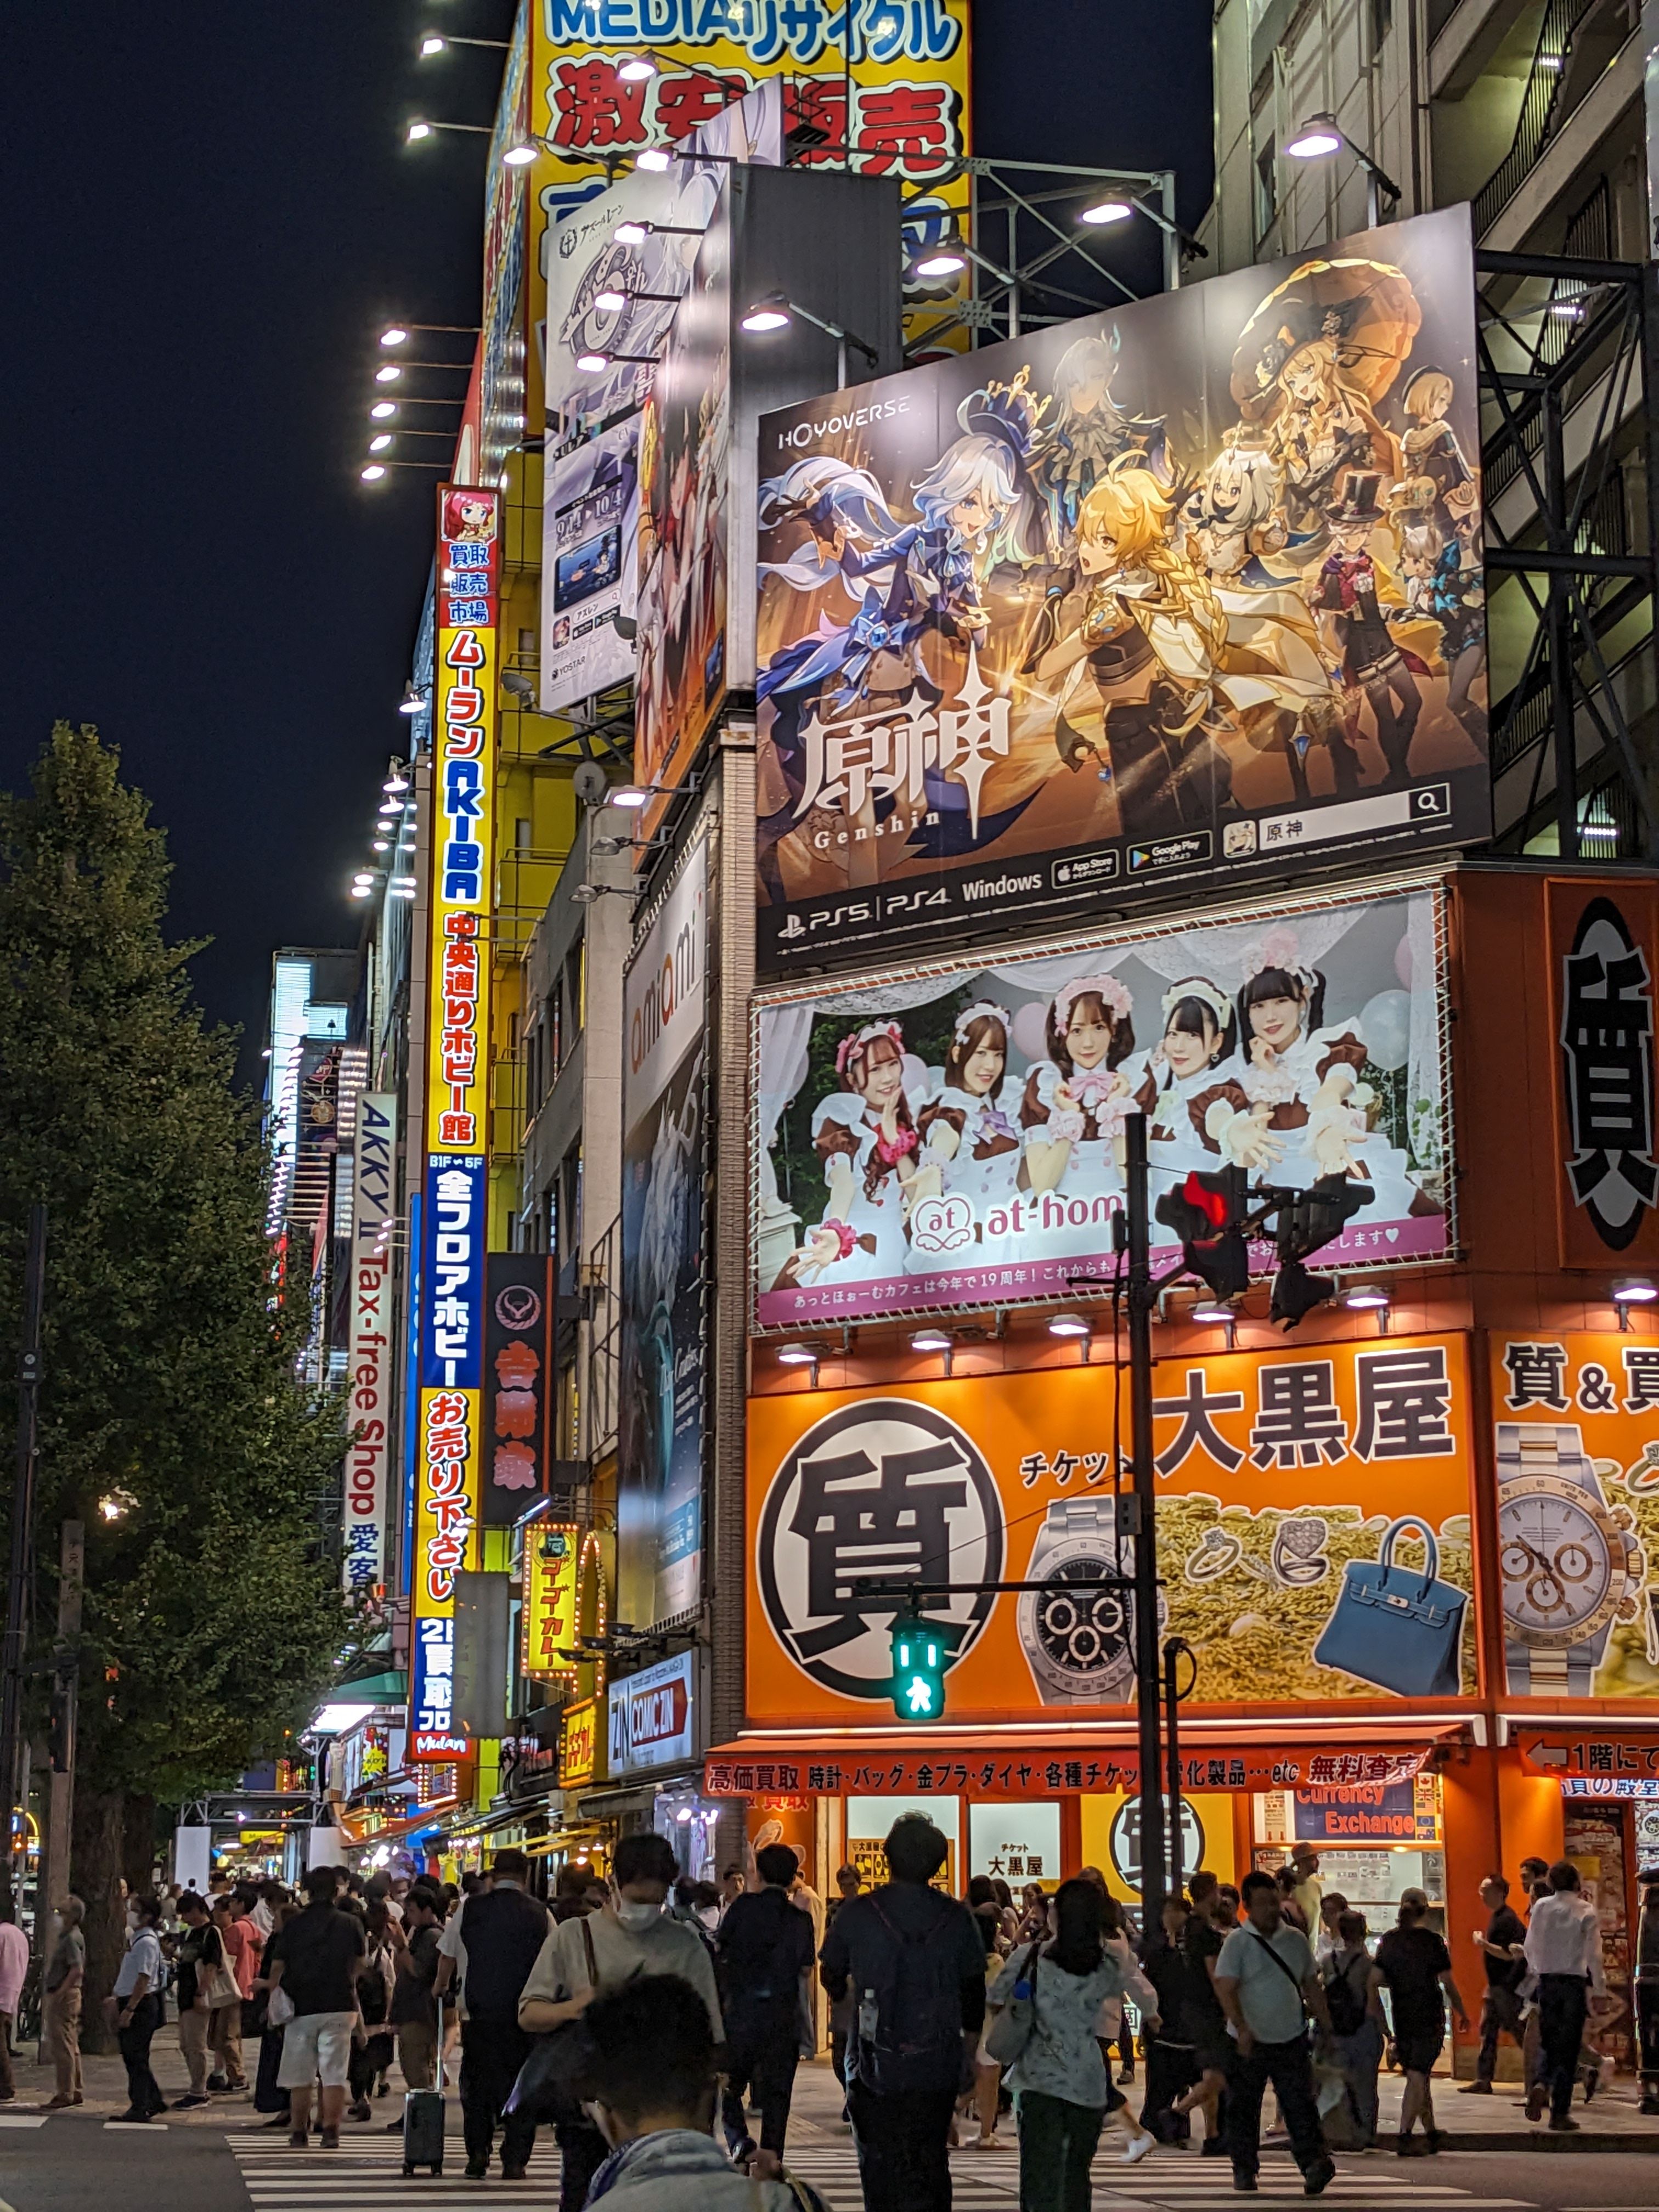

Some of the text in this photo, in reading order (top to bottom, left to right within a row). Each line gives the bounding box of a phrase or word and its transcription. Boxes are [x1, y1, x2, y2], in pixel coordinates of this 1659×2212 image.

[777, 395, 910, 449] HOYOVERSE
[449, 544, 489, 566] 買取
[449, 572, 488, 594] 販売
[449, 600, 488, 623] 市場
[791, 641, 1012, 840] 原神
[814, 811, 940, 849] Genshin
[1152, 840, 1201, 857] Google Play
[1266, 820, 1303, 842] 原神
[809, 902, 872, 930] PS5
[886, 887, 951, 915] PS4
[962, 872, 1042, 901] Windows
[441, 912, 478, 1142] 中央通りホビー館
[1560, 946, 1659, 1208] 質
[360, 1099, 391, 1218] AKKY
[929, 1206, 955, 1231] at
[988, 1194, 1124, 1235] at-hom
[432, 1170, 473, 1387] 全フロアホビー
[356, 1247, 388, 1411] Tax-free
[1153, 1346, 1456, 1479] 大黒屋
[348, 1418, 384, 1515] Shop
[788, 1435, 973, 1664] 質
[540, 1555, 571, 1667] ゴーゴーカレー
[633, 1692, 659, 1742] COMIC
[416, 1735, 466, 1754] Mulan
[709, 1764, 799, 1791] 高価買取
[1296, 1786, 1385, 1805] Currency
[1325, 1811, 1414, 1835] Exchange
[988, 1855, 1043, 1876] 大黒屋
[1001, 1843, 1029, 1853] チケット
